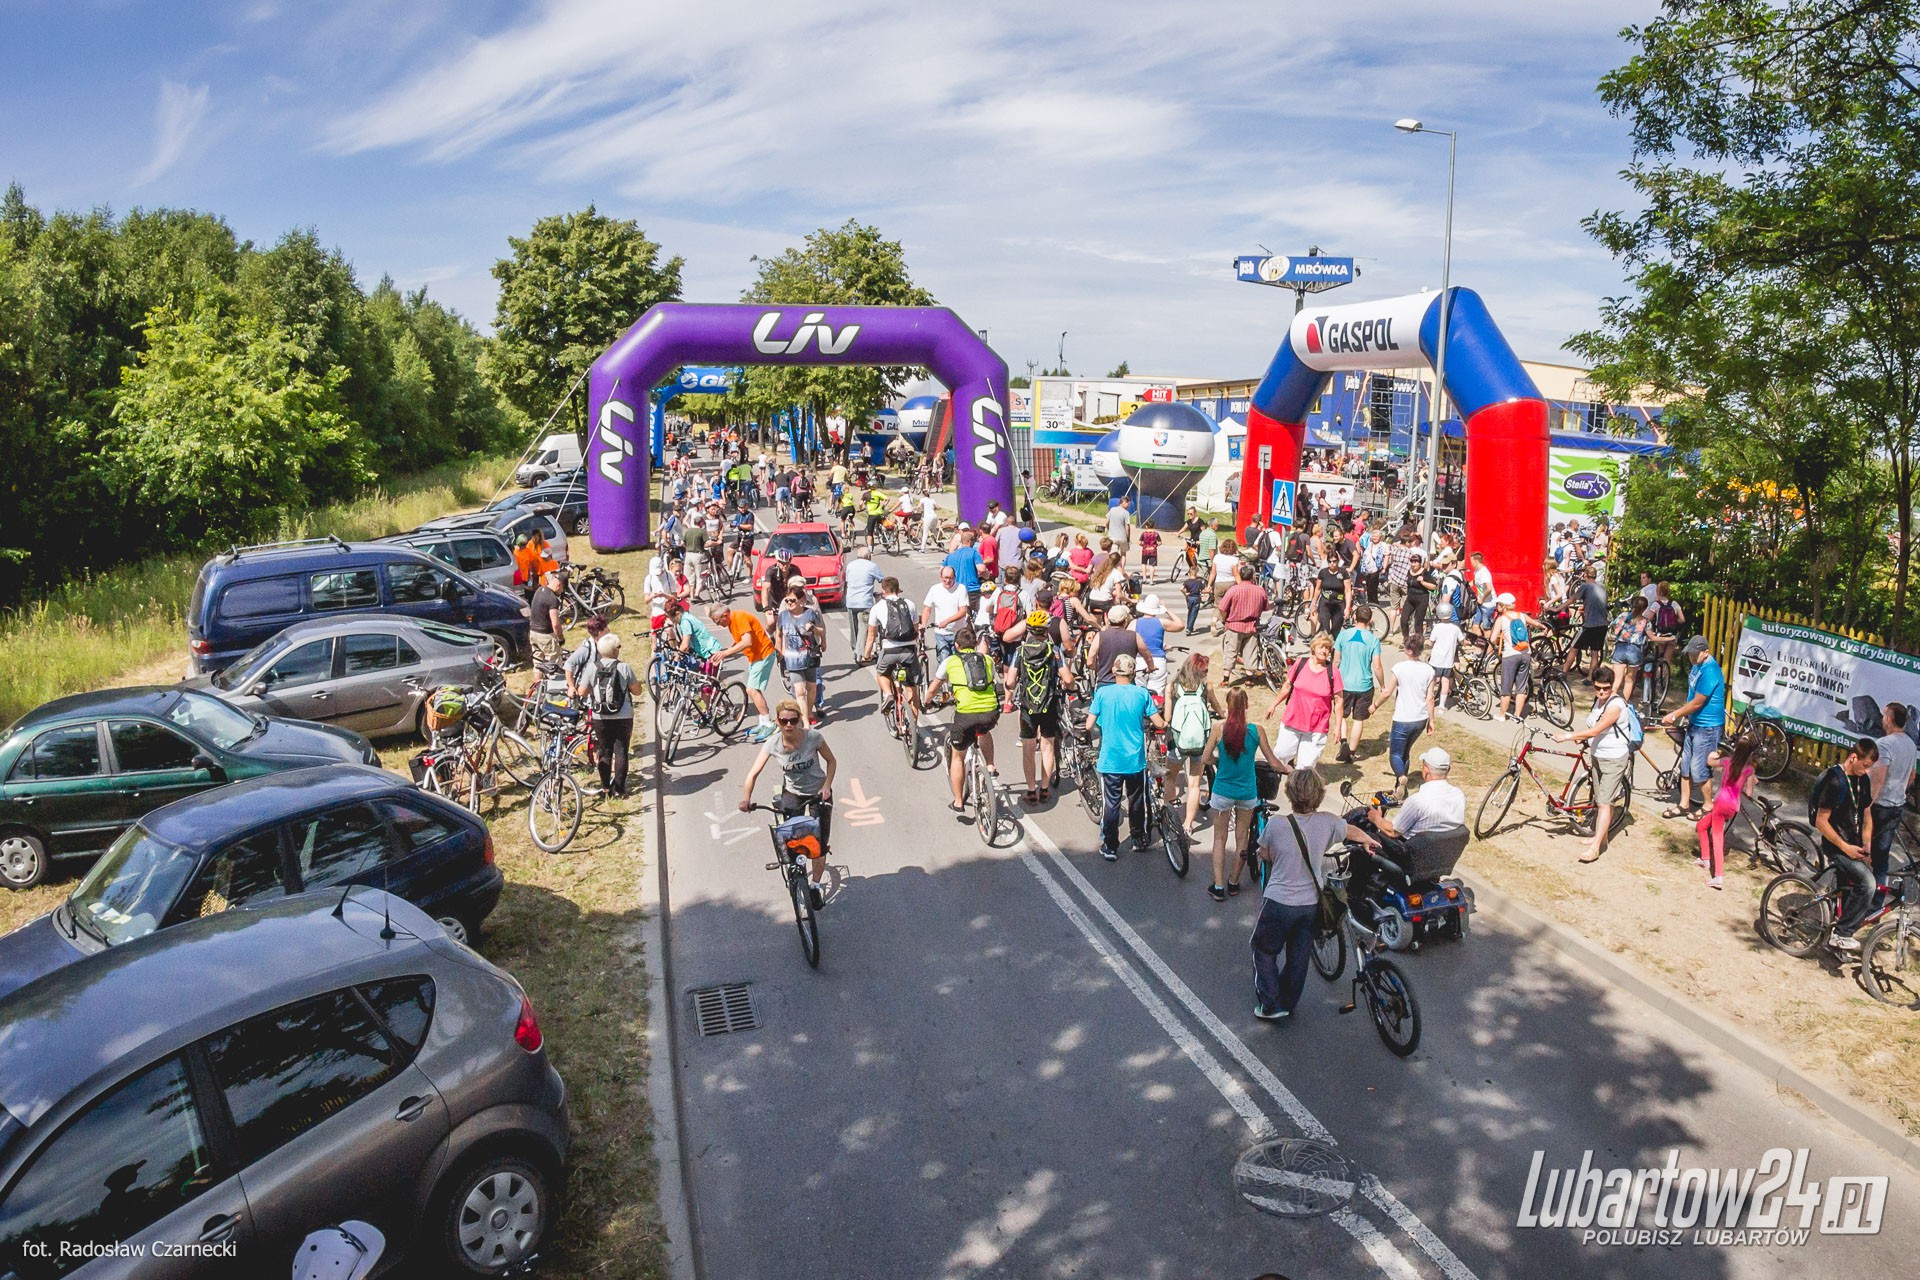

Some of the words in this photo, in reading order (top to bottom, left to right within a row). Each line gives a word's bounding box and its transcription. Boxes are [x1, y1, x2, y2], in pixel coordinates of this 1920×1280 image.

[1295, 261, 1348, 275] MRÓWKA
[752, 311, 861, 354] Liv
[1328, 317, 1400, 352] GASPOL
[1152, 390, 1168, 398] HIT
[1565, 479, 1589, 490] Stella
[1761, 622, 1842, 649] autoryzowany
[1839, 637, 1910, 668] dystrybutor
